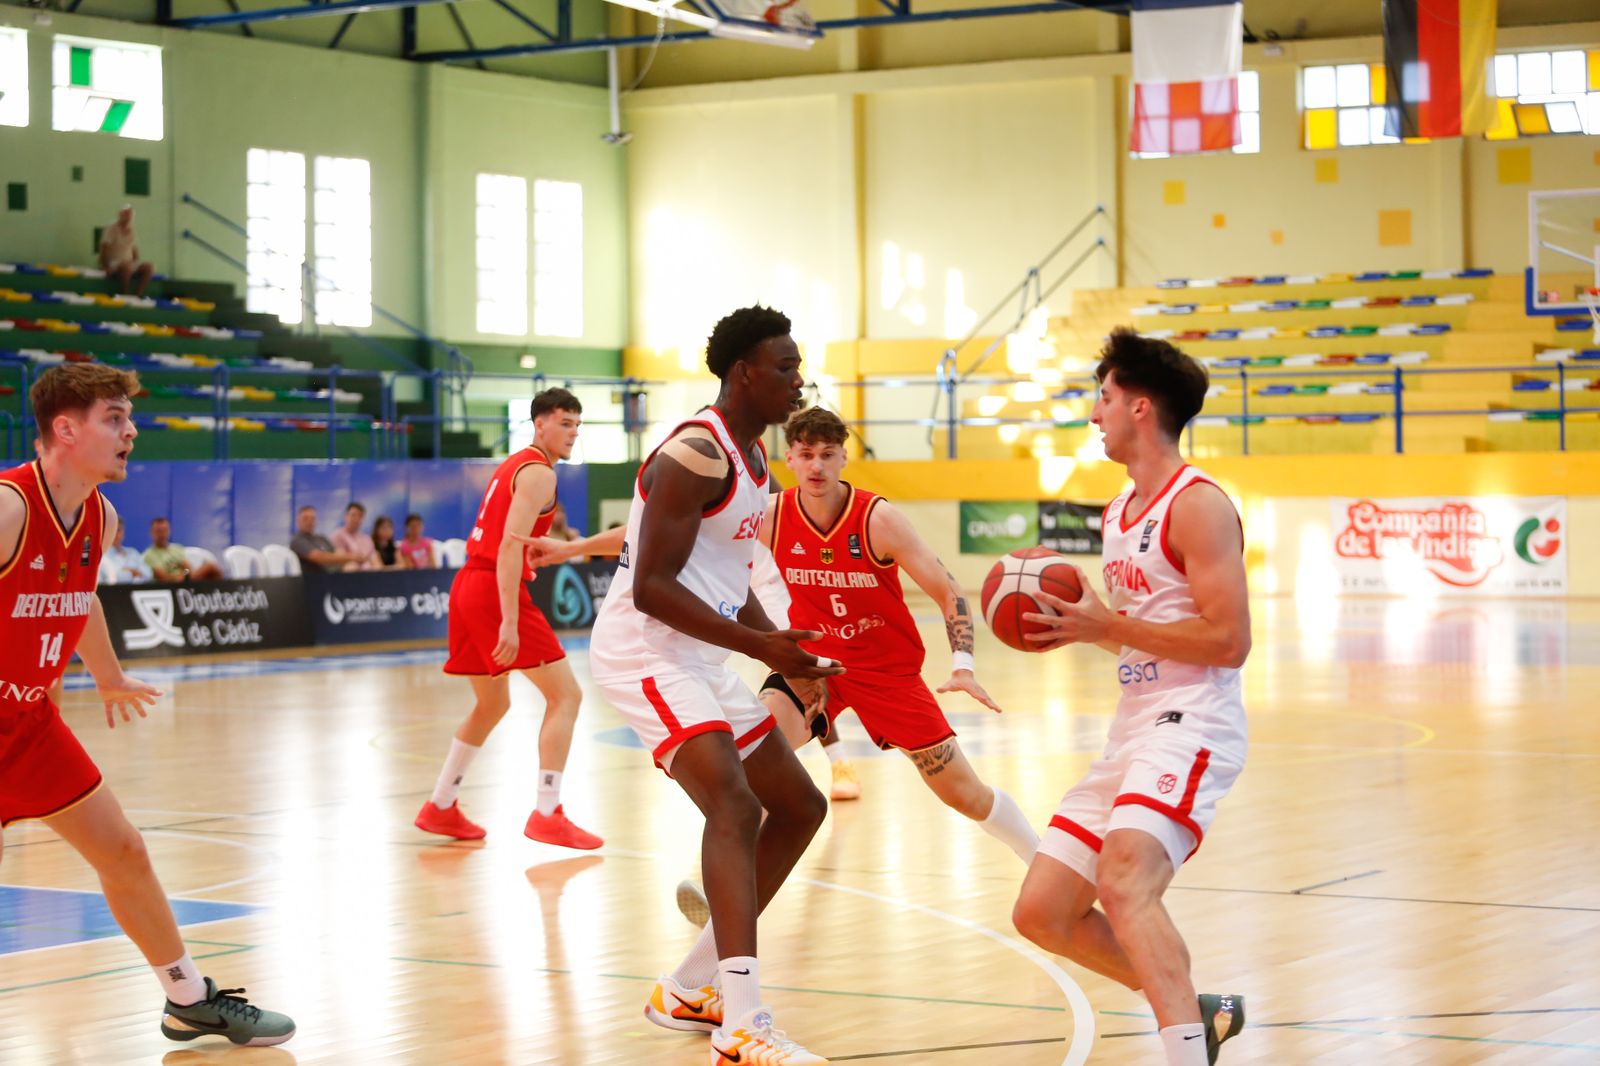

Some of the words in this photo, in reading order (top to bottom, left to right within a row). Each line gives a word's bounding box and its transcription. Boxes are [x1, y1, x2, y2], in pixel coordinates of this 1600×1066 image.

[1350, 503, 1486, 537] Compañía
[1338, 533, 1371, 556] de
[785, 566, 880, 589] DEUTSCHLAND
[1103, 555, 1153, 596] SPAÑA
[10, 591, 93, 618] DEUTSCHLAN
[176, 586, 269, 617] Diputación
[828, 593, 848, 618] 6
[187, 621, 212, 647] de
[212, 618, 263, 646] Cádiz
[38, 632, 64, 669] 14
